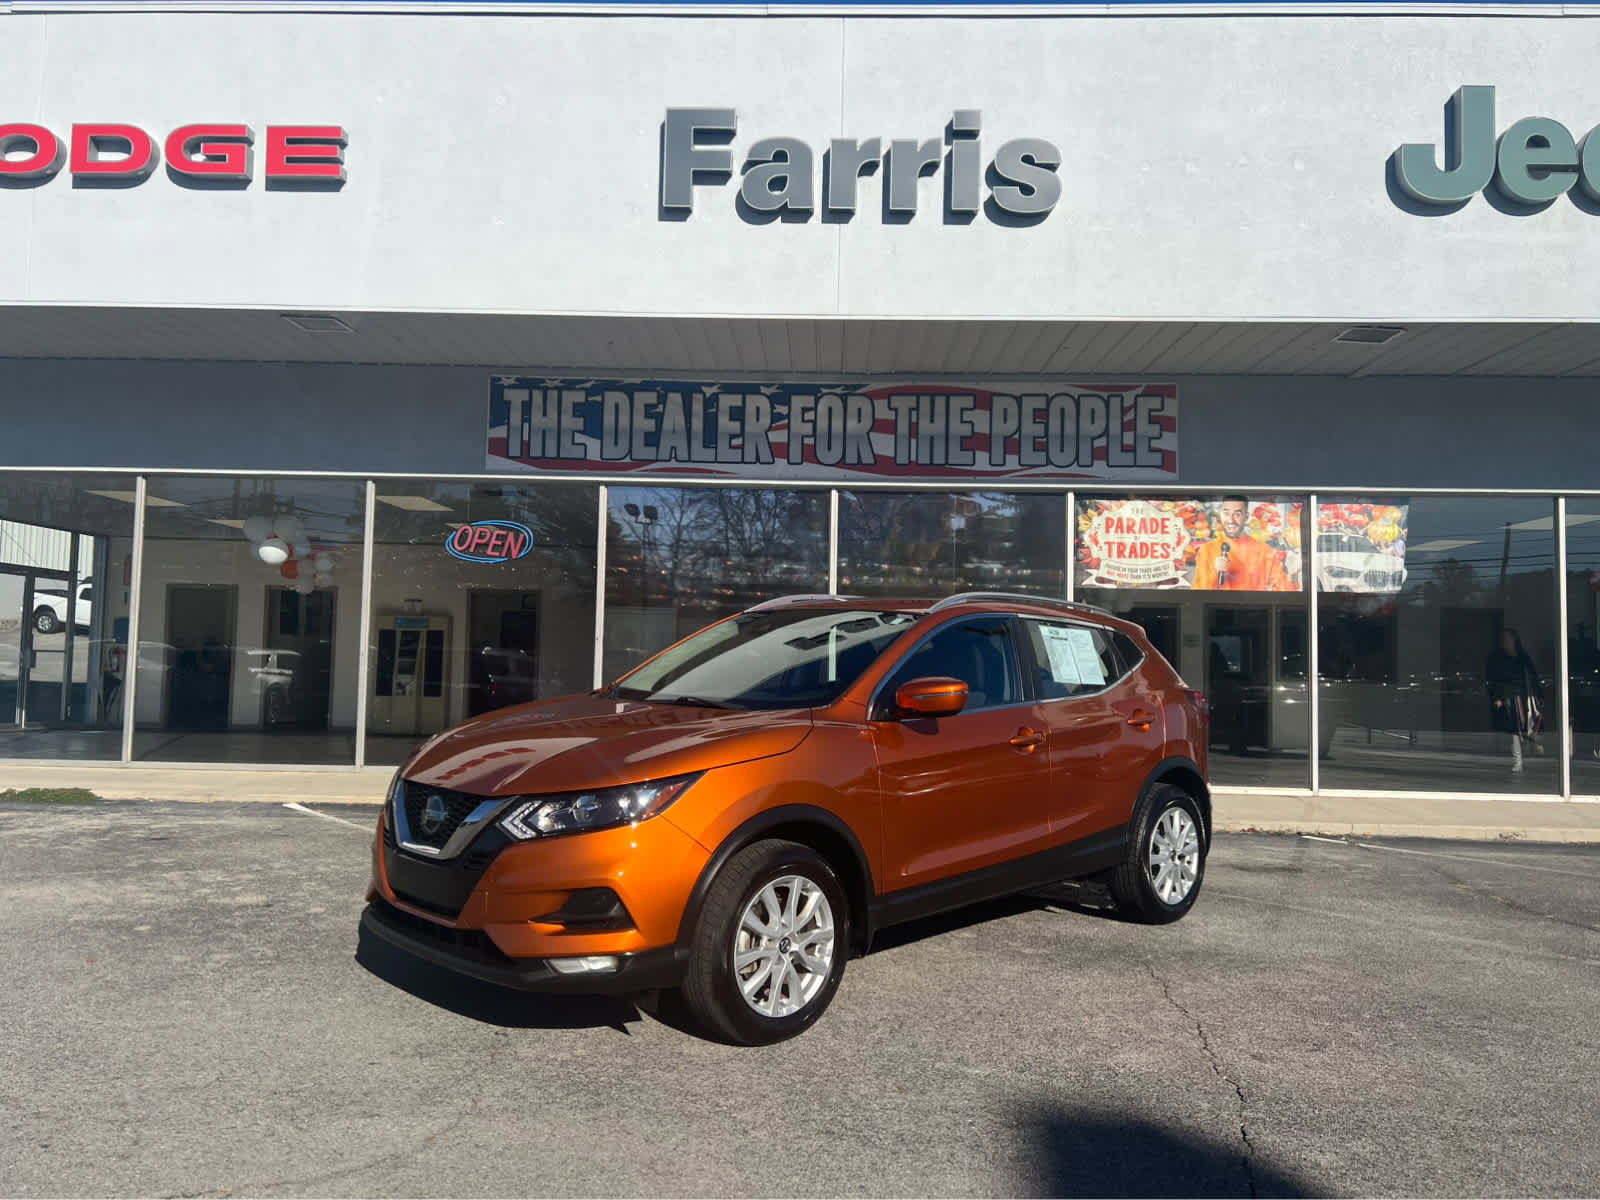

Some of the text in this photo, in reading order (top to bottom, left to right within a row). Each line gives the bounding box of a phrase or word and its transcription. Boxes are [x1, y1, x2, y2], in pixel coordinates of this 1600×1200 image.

[661, 107, 1062, 217] Farris
[1395, 85, 1600, 203] Je
[503, 388, 1165, 467] THE DEALER FOR THE PEOPLE
[453, 525, 525, 559] OPEN
[1104, 541, 1171, 559] TRADES
[1105, 517, 1170, 535] PARADE
